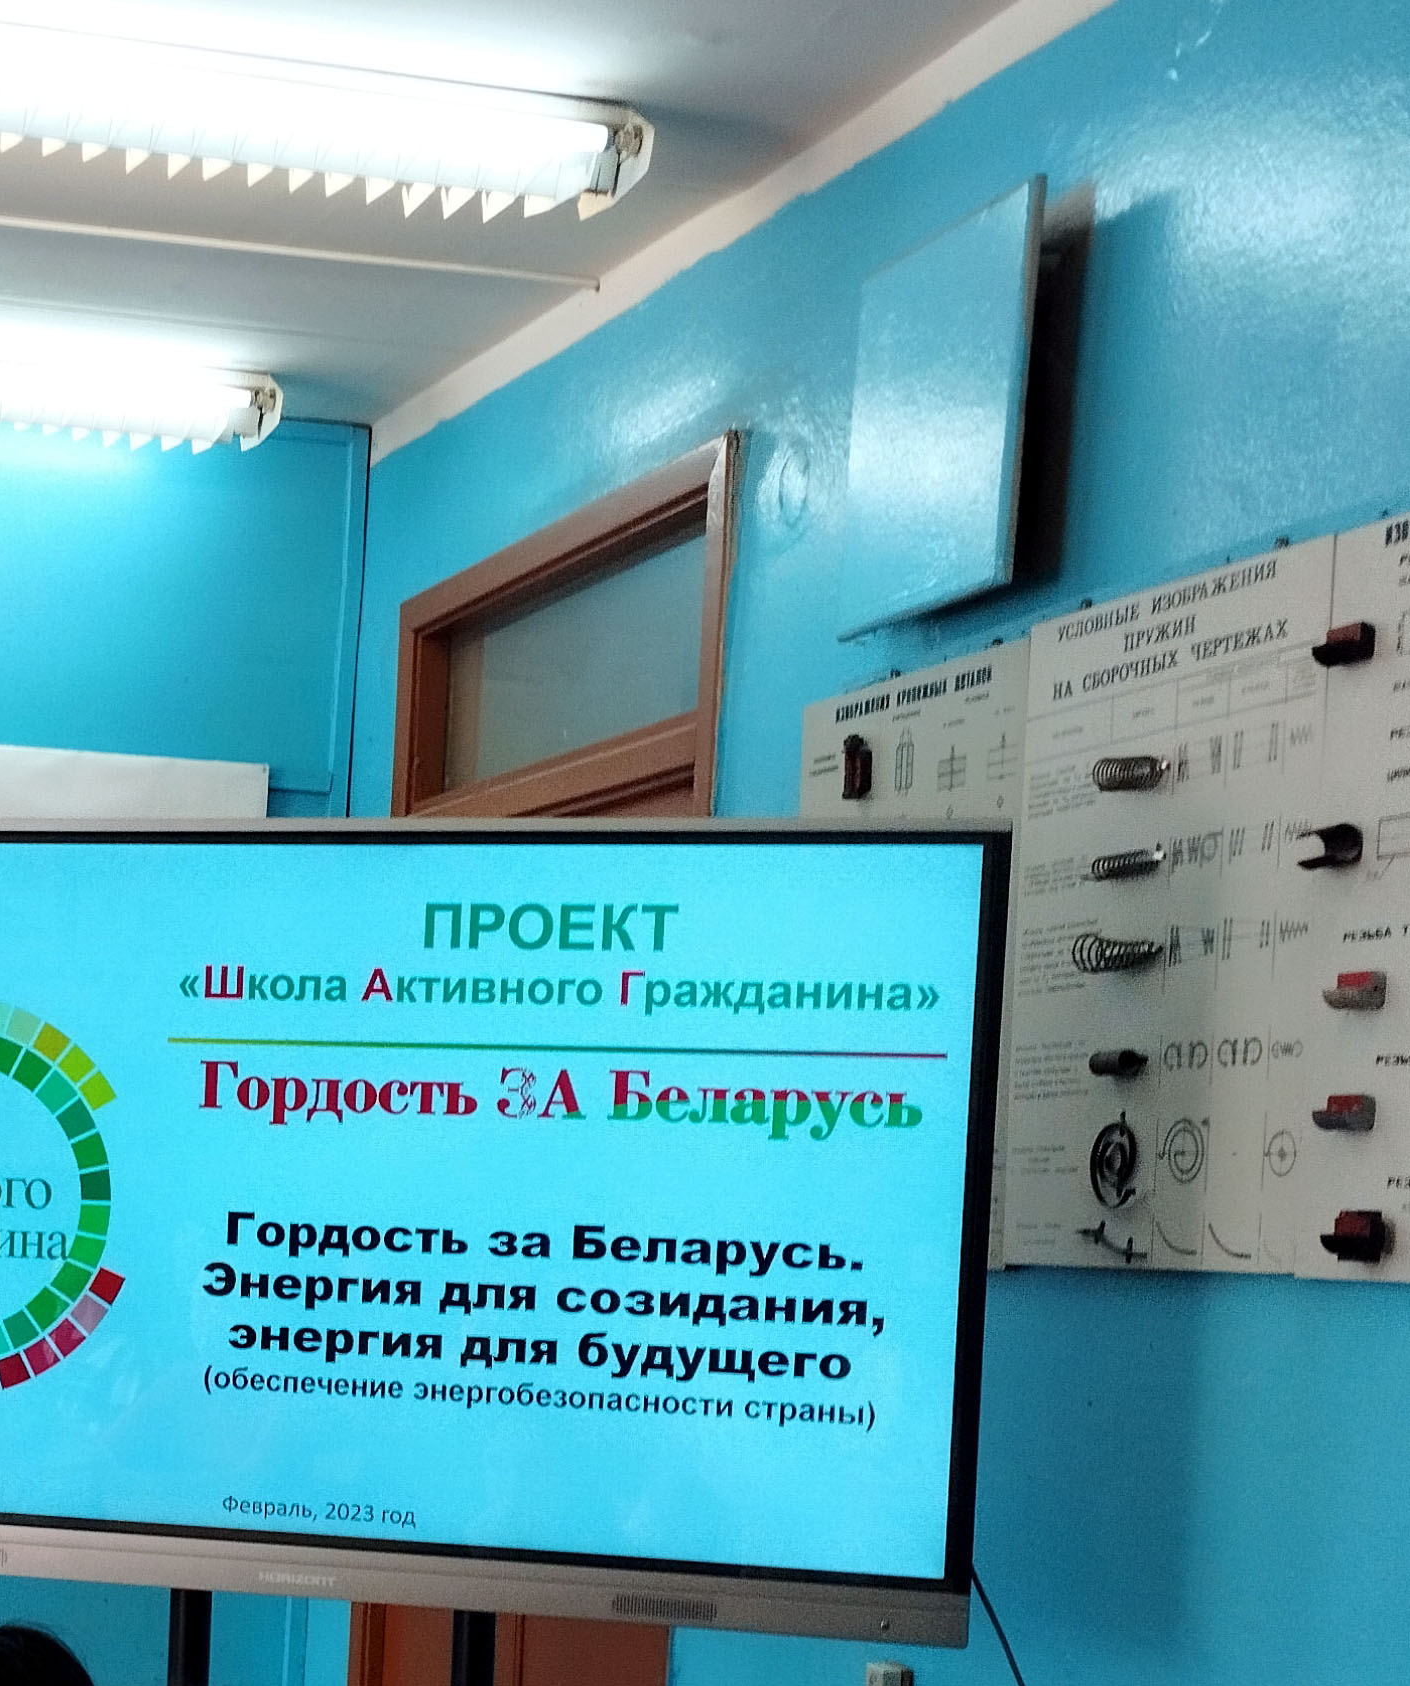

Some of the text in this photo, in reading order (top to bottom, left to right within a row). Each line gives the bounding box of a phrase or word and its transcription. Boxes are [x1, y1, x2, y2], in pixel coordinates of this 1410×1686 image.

[1053, 680, 1073, 700] НА
[1191, 618, 1288, 661] ЧЕРТЕЖАХ
[1124, 614, 1196, 653] ПРУЖИН
[423, 901, 679, 952] ПРОЕКТ
[180, 965, 939, 1016] «Школа Активного Гражданина»
[199, 1060, 477, 1125] Гордость
[607, 1070, 923, 1142] Беларусь
[225, 1211, 864, 1276] Гордость за Беларусь.
[202, 1262, 885, 1336] Энергия для созидания,
[228, 1322, 851, 1382] энергия для будущего
[204, 1365, 875, 1431] (обеспечение энергобезопасности страны)
[222, 1495, 416, 1528] Февраль, 2023 год
